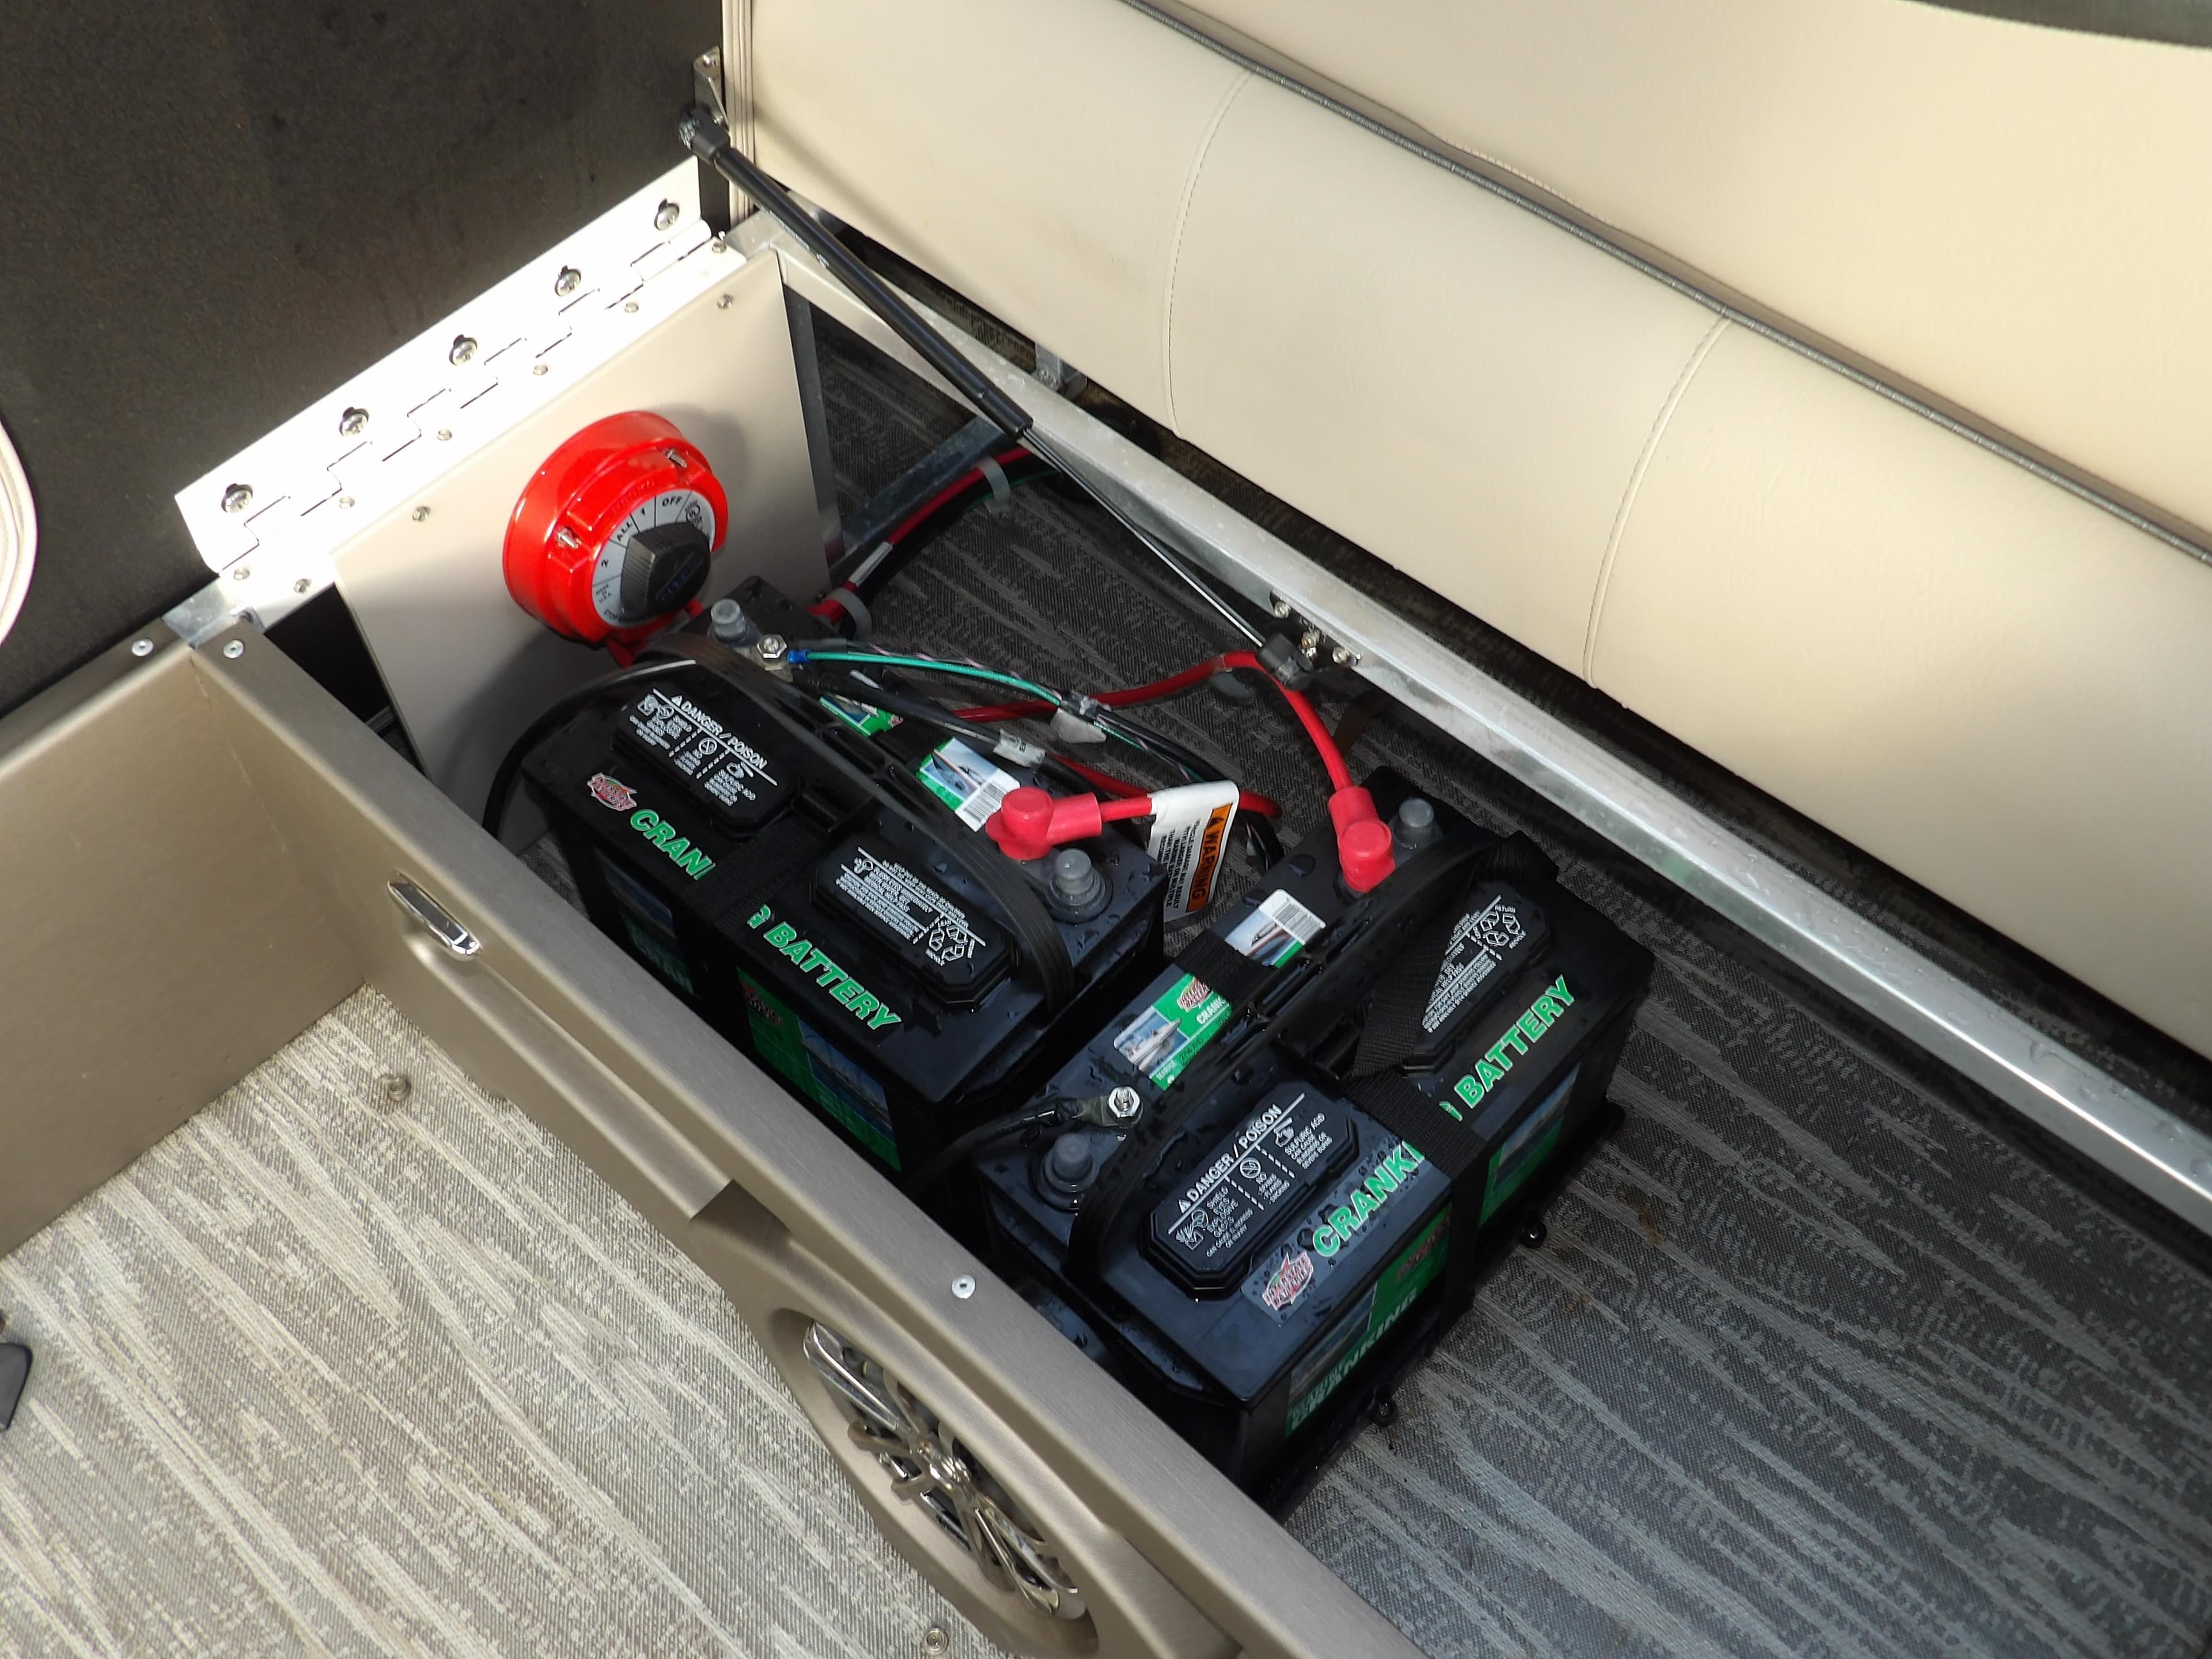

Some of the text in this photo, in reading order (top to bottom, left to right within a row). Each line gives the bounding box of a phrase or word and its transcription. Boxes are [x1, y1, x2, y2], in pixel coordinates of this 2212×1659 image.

[640, 507, 645, 516] 1
[661, 495, 682, 506] OFF
[616, 520, 632, 541] ALL
[601, 558, 609, 567] 2
[681, 701, 722, 736] DANGER
[728, 736, 767, 769] POISON
[1176, 842, 1186, 868] LARGER
[1191, 830, 1219, 900] WARNING
[1166, 878, 1177, 907] MULTIPLE
[1173, 886, 1183, 908] RESULT
[763, 921, 902, 1031] BATTERY
[1454, 974, 1575, 1109] BATTERY
[1285, 1113, 1324, 1155] SULFURIC ACID
[1187, 1153, 1234, 1202] DANGER
[1238, 1104, 1282, 1149] POISON
[1256, 1172, 1267, 1184] NO
[1207, 1187, 1228, 1209] SHIELD
[1204, 1198, 1238, 1233] EXPLOSIVE
